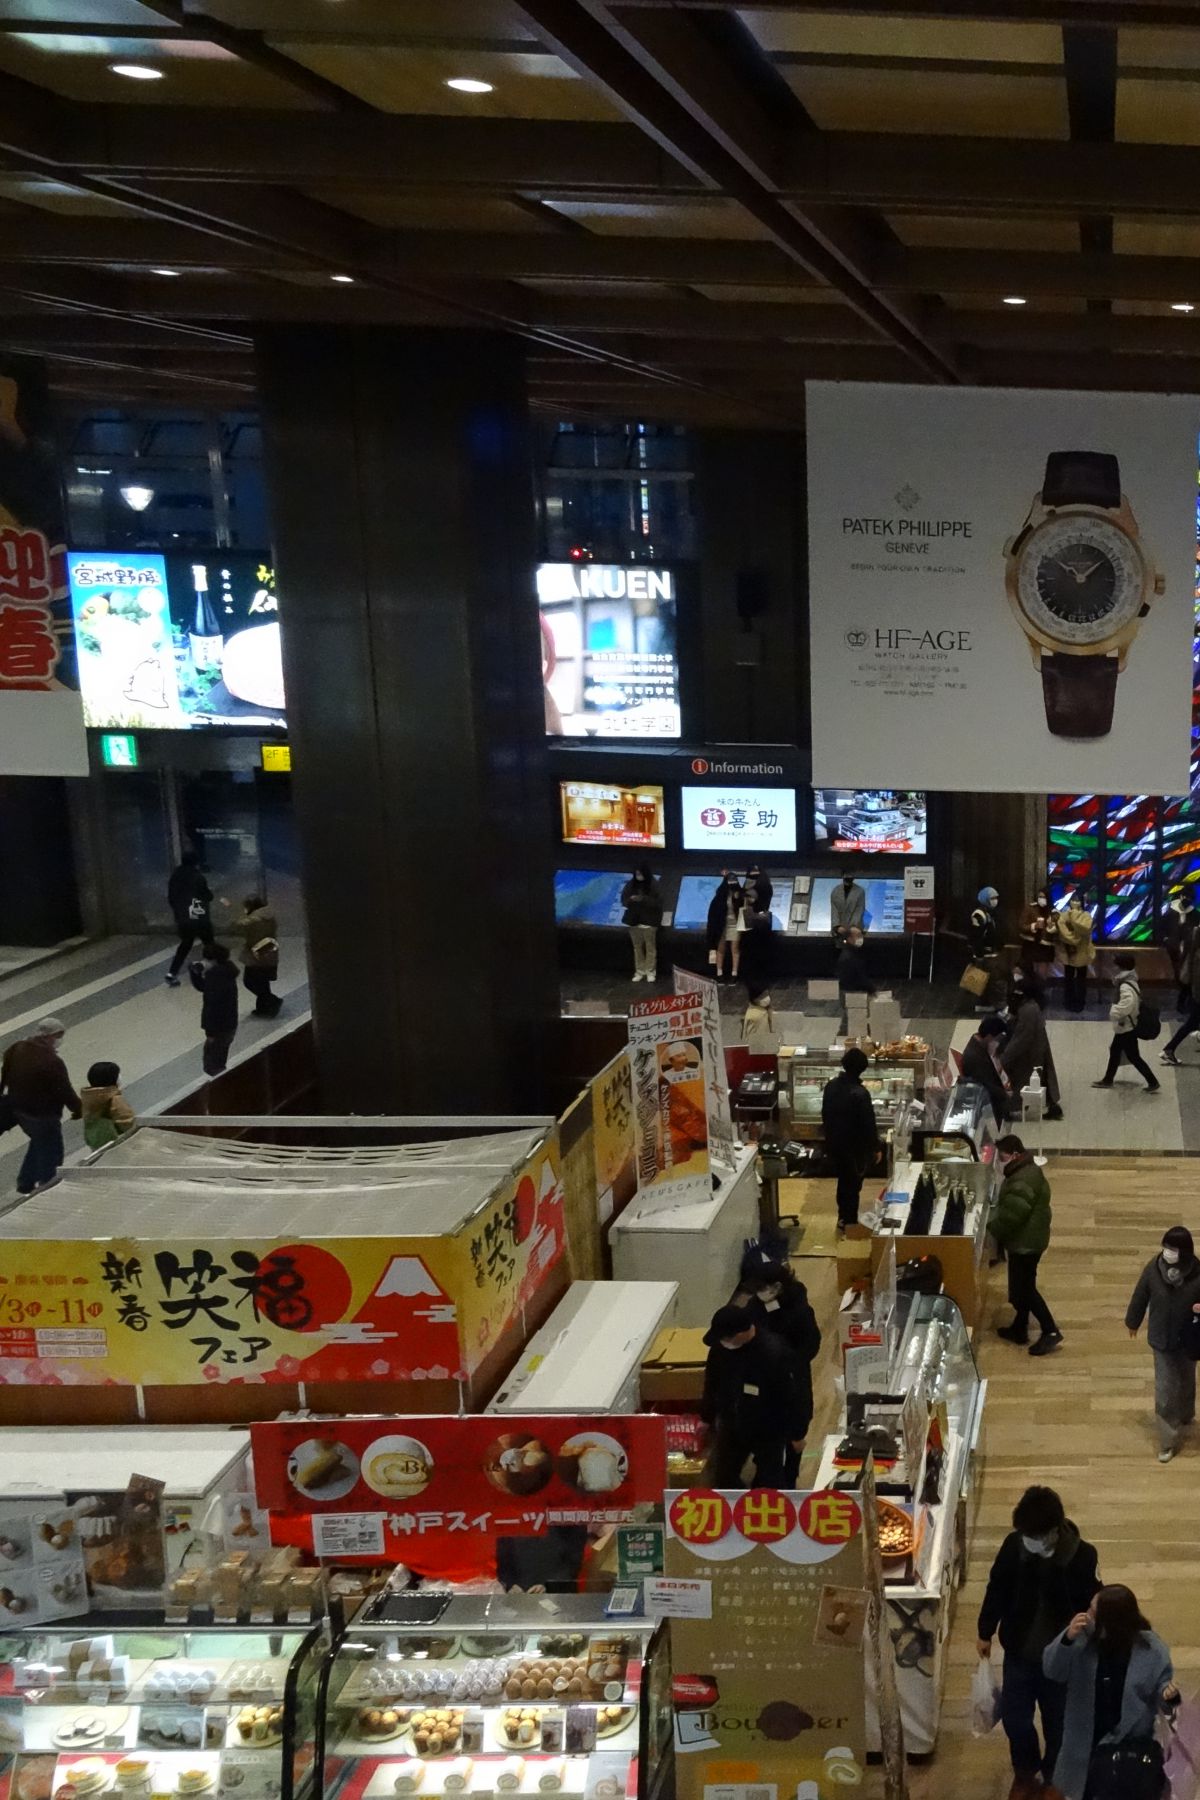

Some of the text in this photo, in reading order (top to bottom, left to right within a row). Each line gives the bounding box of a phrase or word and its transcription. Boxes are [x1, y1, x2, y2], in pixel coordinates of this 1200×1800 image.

[843, 518, 972, 538] PATEK PHILIPPE
[875, 628, 972, 651] HF-AGE
[710, 761, 783, 775] Information
[101, 1251, 152, 1332] 新春
[155, 1250, 313, 1331] 笑福
[191, 1336, 272, 1364] フェア
[389, 1511, 545, 1535] 神戸スイーツ
[675, 1494, 853, 1541] 初出店
